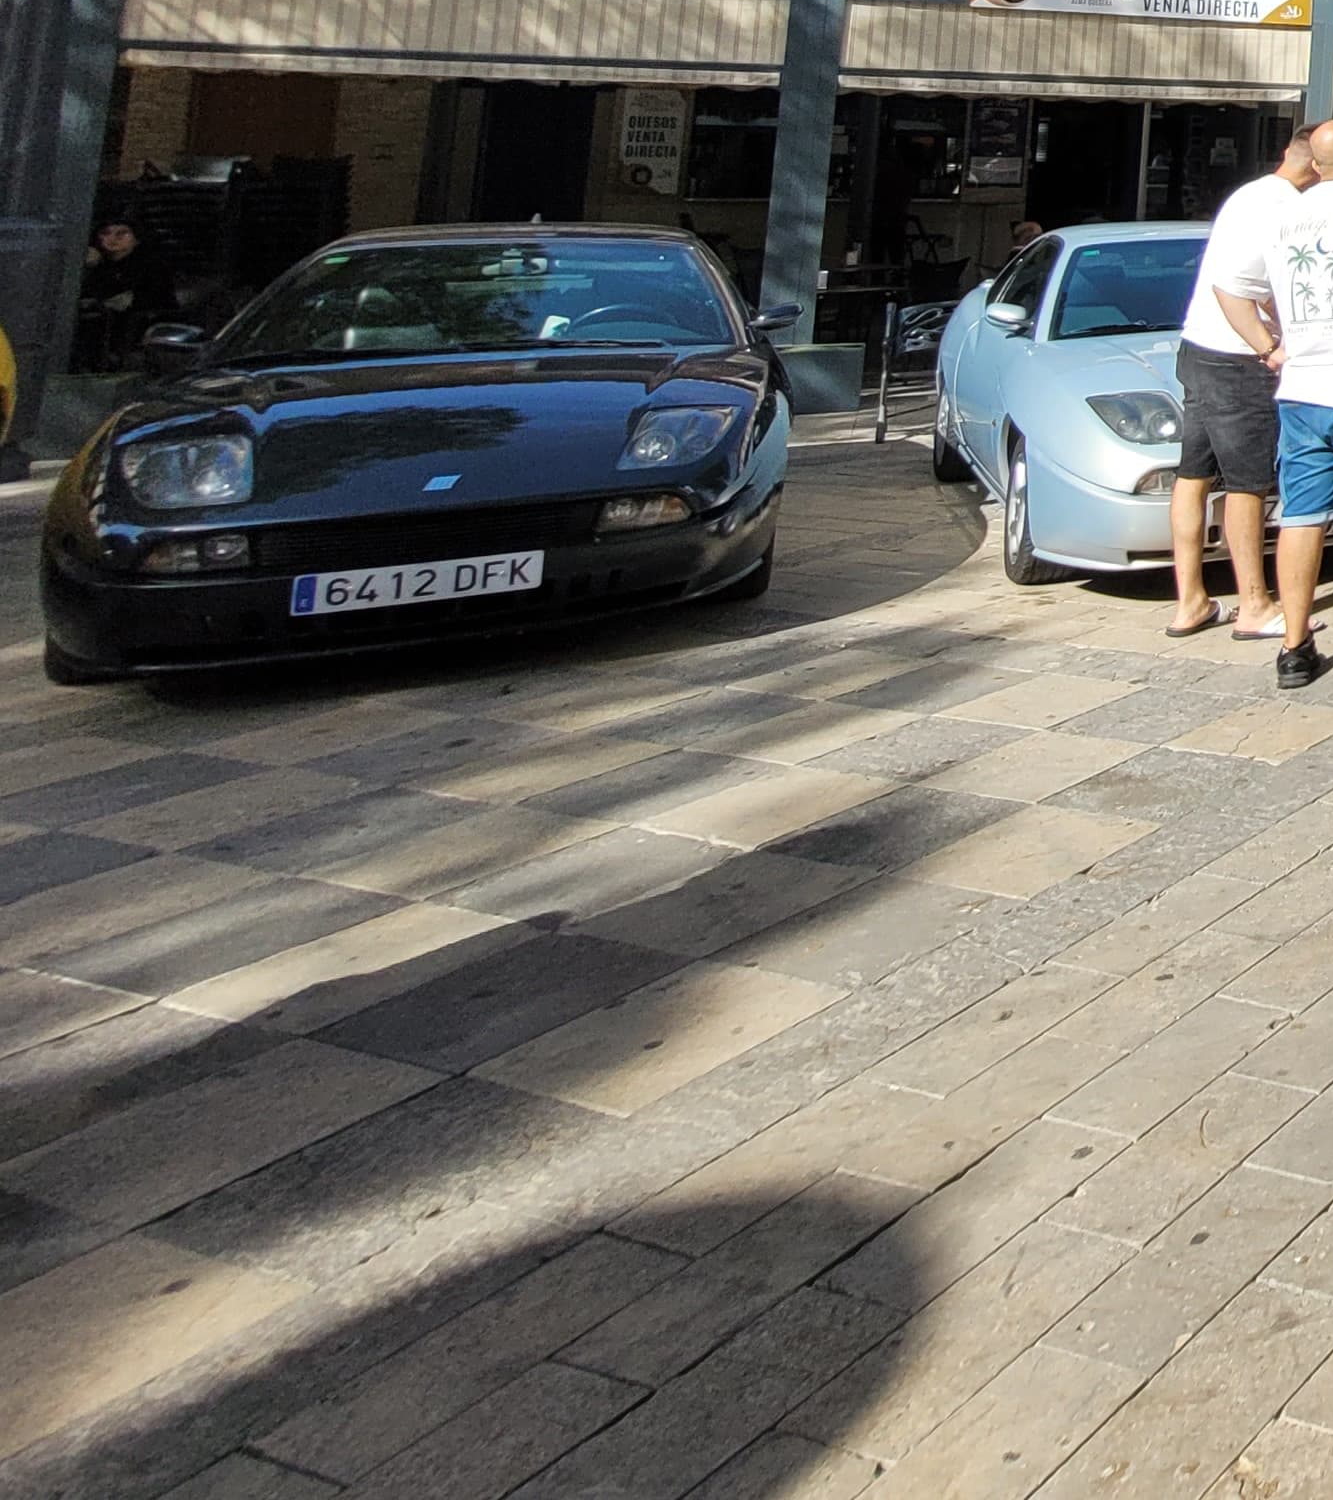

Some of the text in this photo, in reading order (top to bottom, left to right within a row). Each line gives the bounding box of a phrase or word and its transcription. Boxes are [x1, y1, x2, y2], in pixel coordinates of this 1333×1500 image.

[628, 115, 679, 129] QUESOS
[627, 131, 666, 143] VENTA
[625, 145, 678, 158] DIRECTA
[325, 557, 533, 606] 6412 DFK
